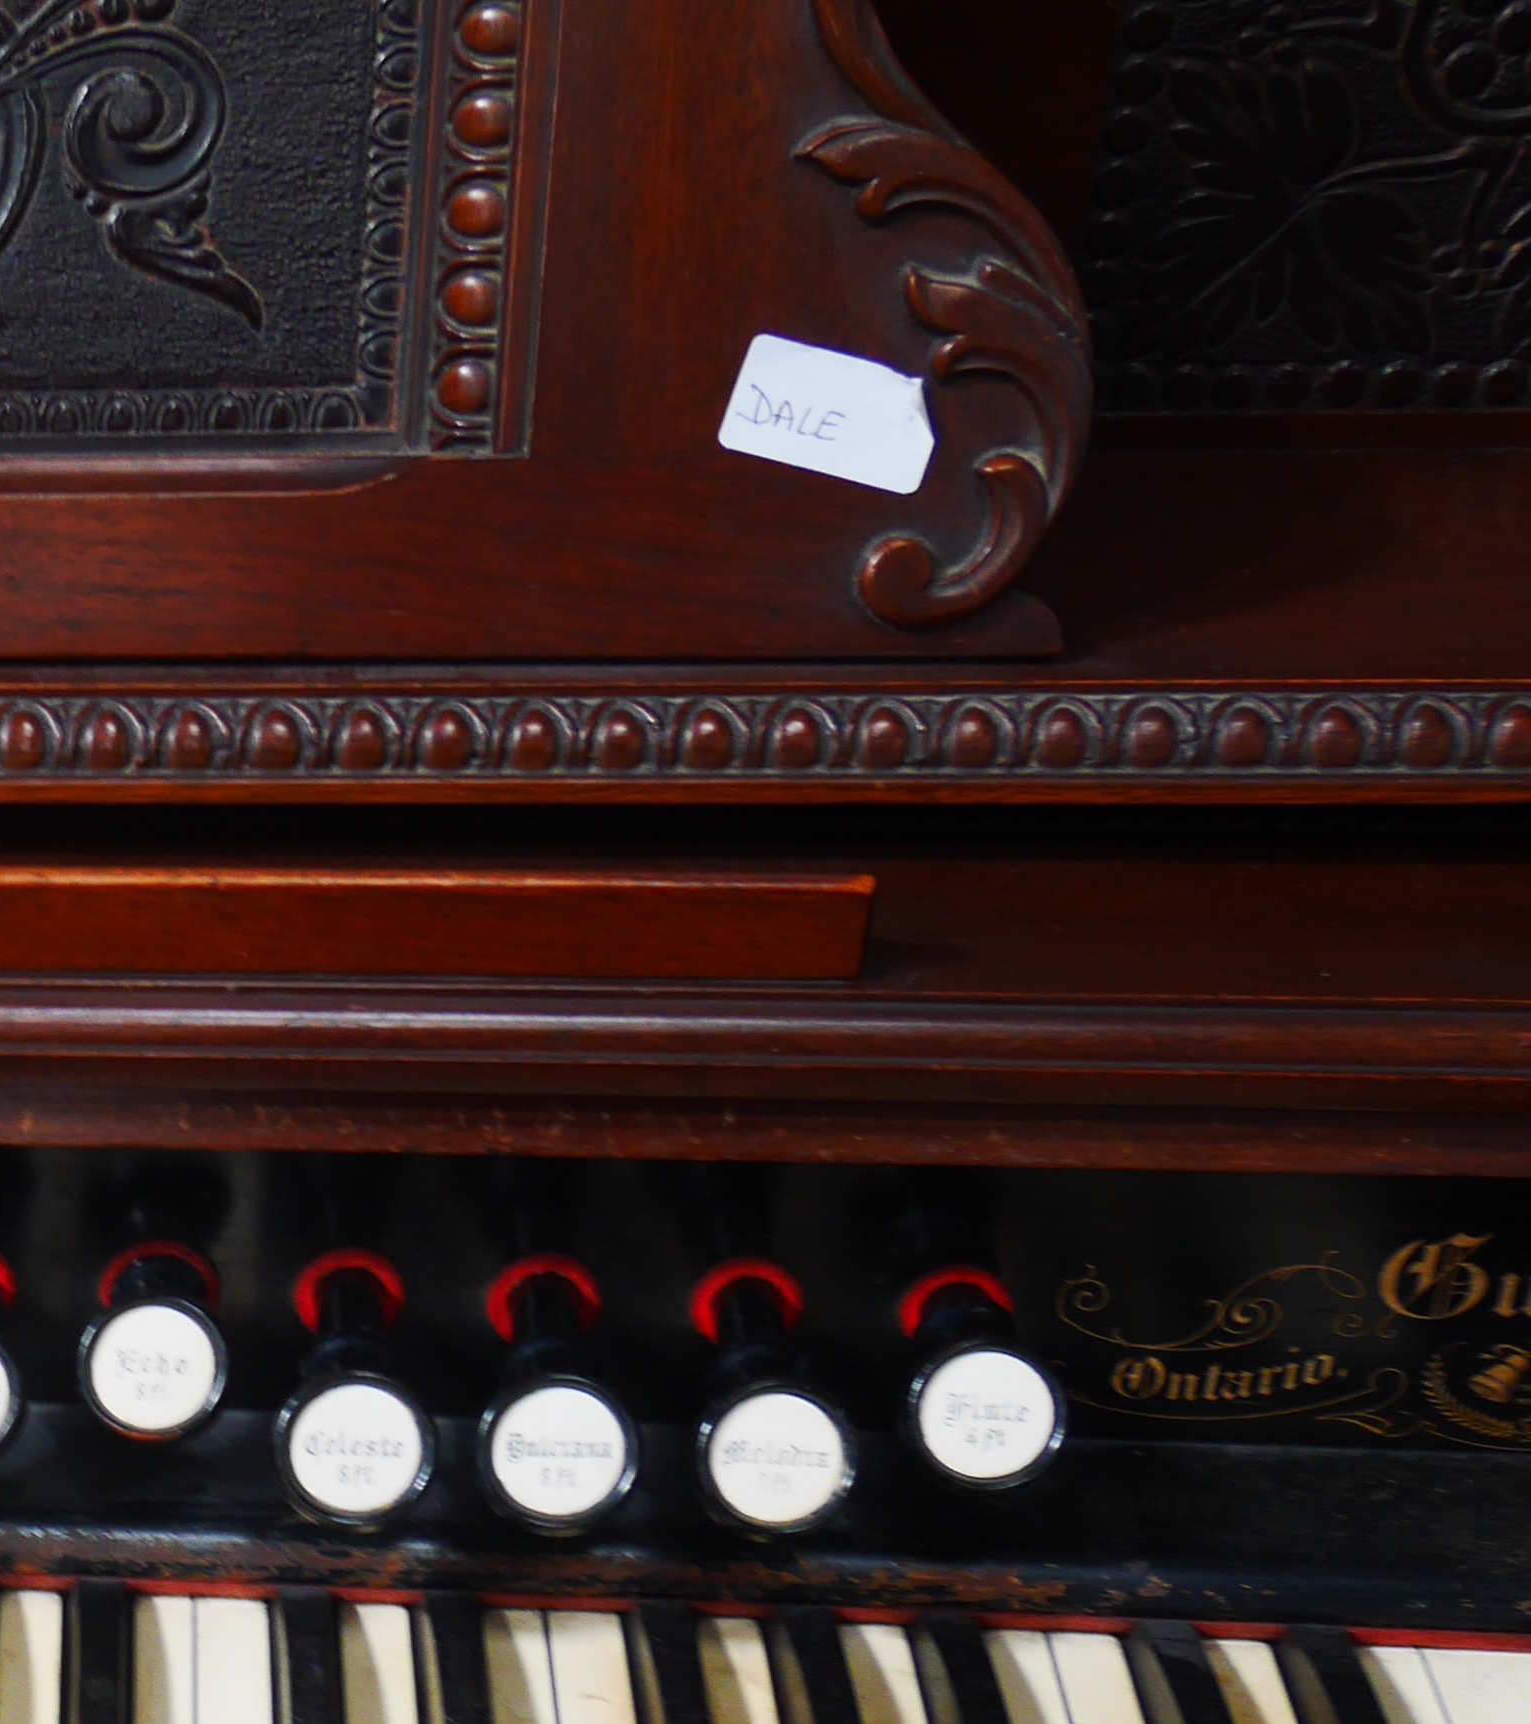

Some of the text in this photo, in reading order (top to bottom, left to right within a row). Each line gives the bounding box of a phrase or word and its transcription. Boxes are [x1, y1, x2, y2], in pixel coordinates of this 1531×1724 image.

[735, 383, 847, 441] DALE
[116, 1348, 189, 1378] Echo
[1110, 1345, 1350, 1402] Ontario.
[942, 1391, 1030, 1428] Flute
[304, 1429, 406, 1458] Celeste
